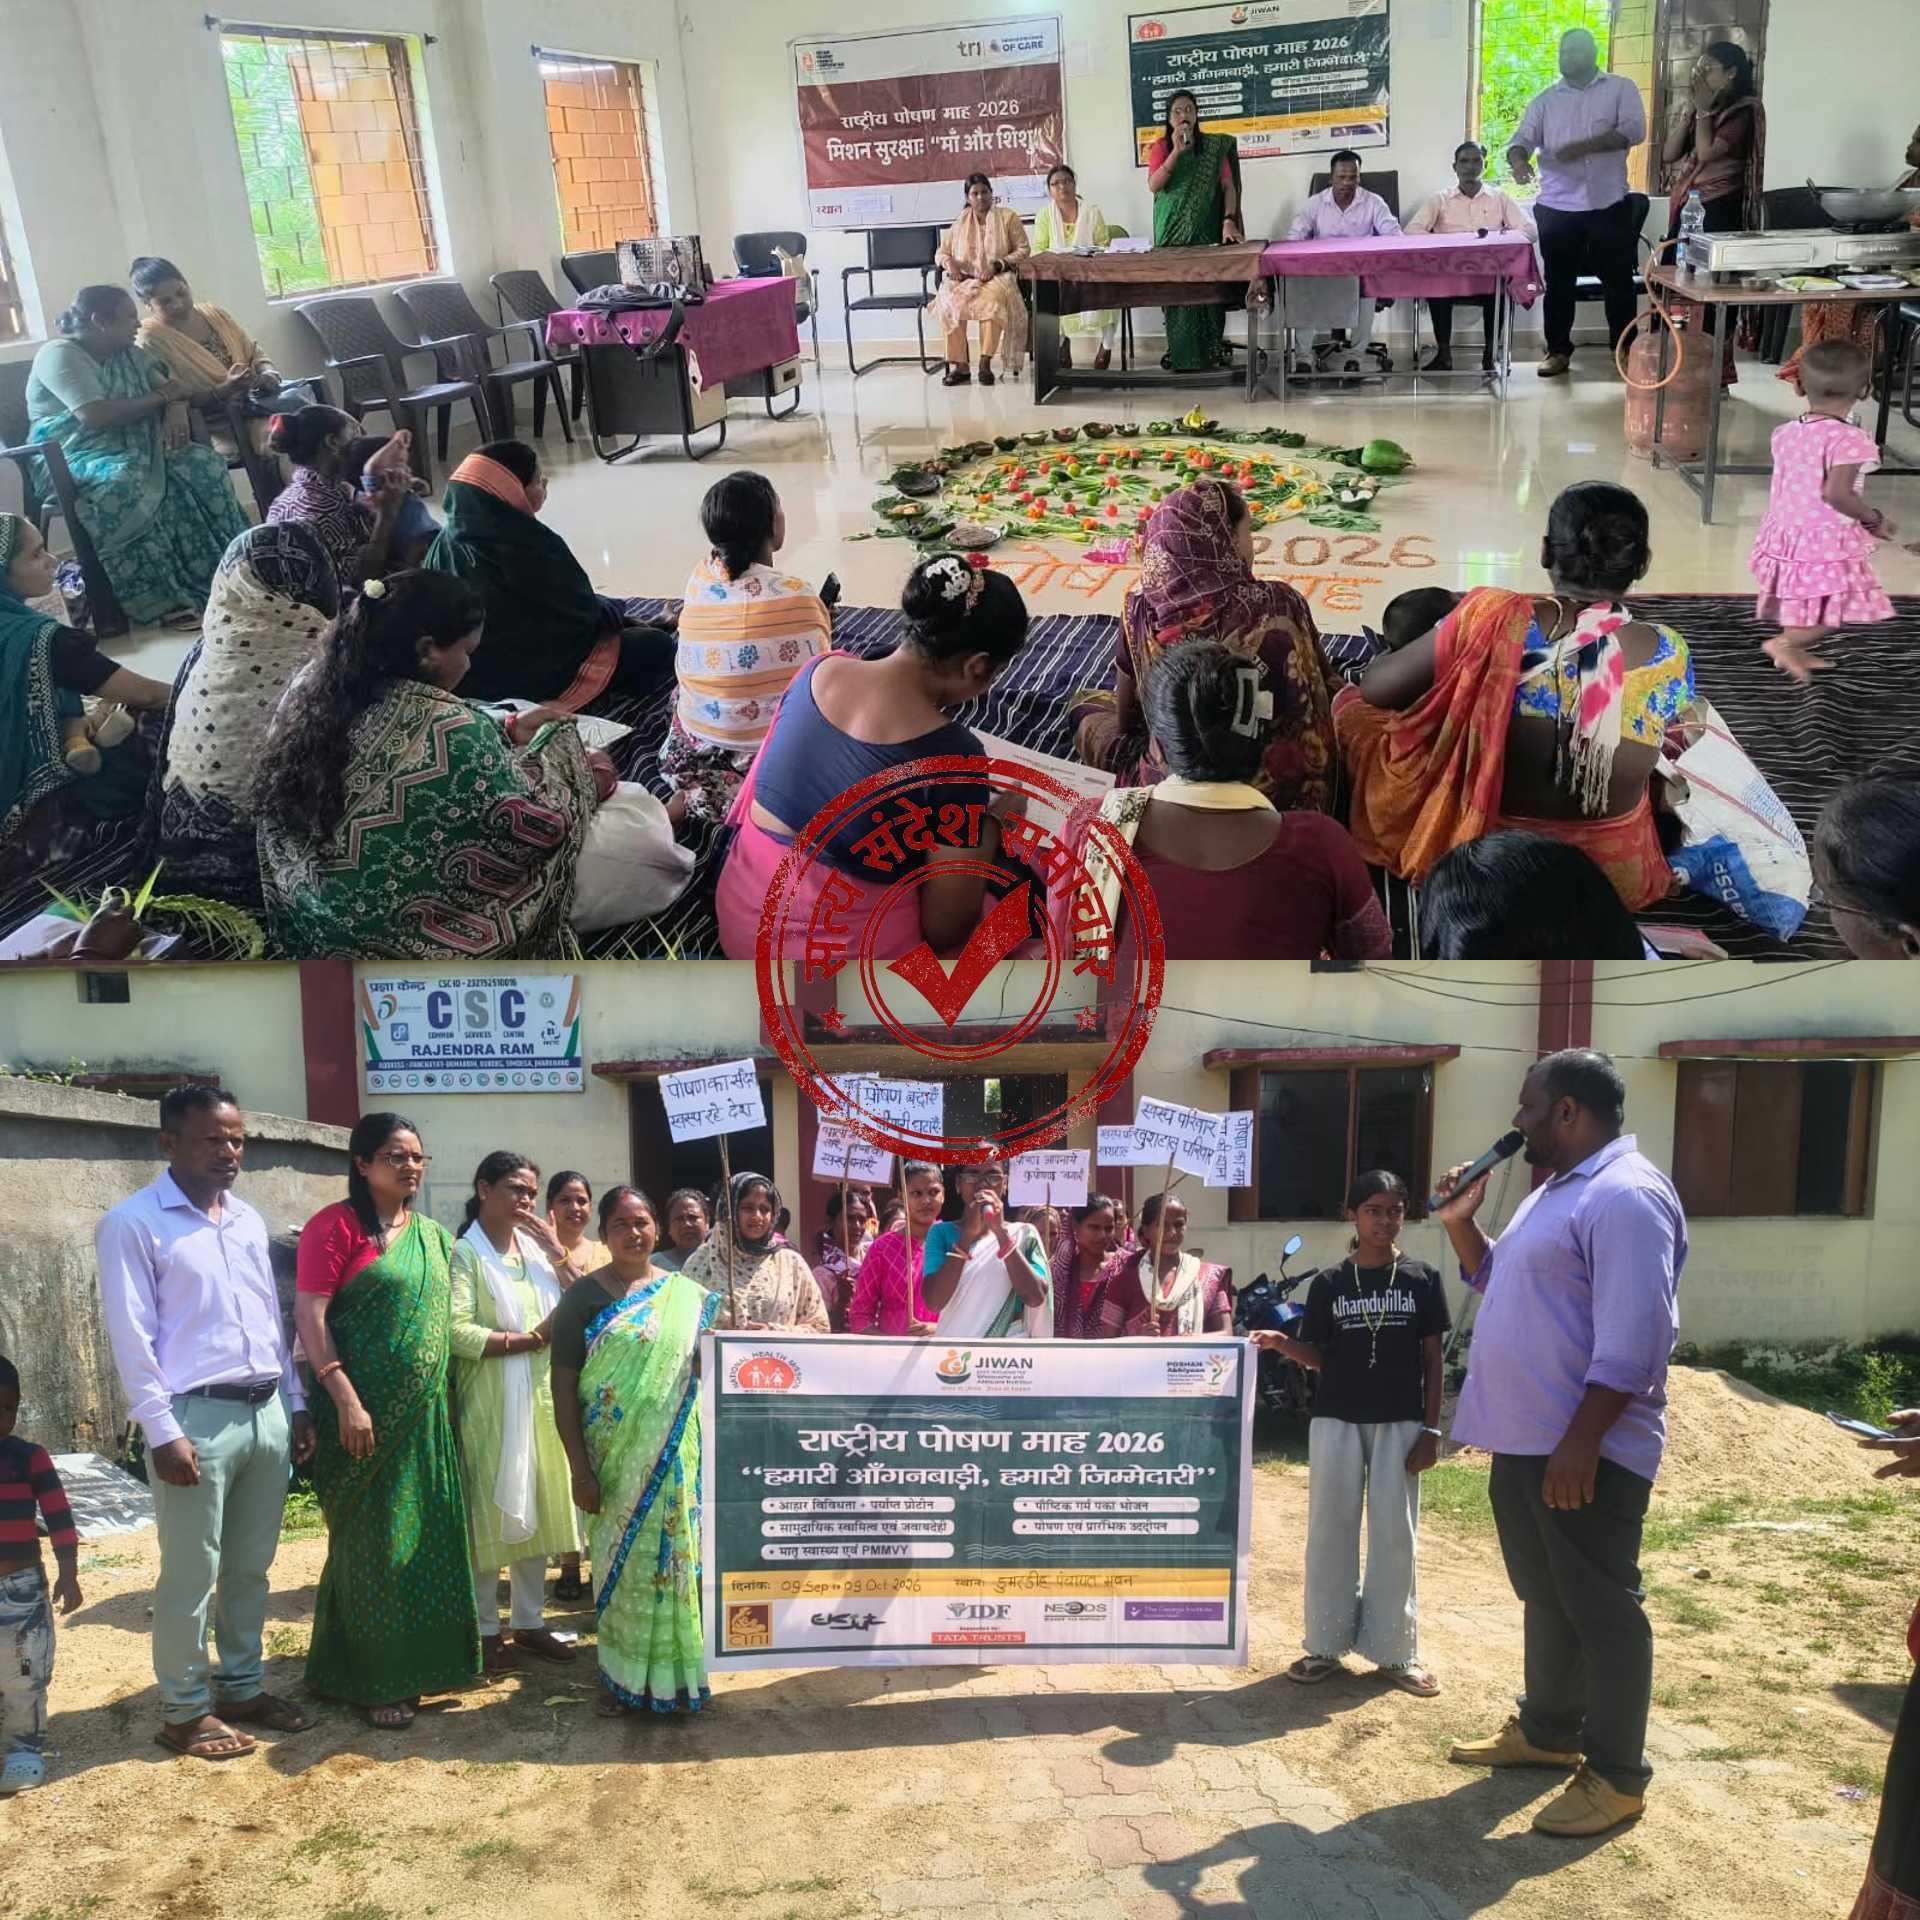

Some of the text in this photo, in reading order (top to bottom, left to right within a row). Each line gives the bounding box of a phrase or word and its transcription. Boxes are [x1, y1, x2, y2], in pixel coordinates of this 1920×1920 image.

[1002, 40, 1044, 52] OF CARE
[1166, 35, 1349, 69] राष्ट्रीय पोषण माह 2026
[1263, 59, 1300, 75] हमारी
[840, 99, 1019, 131] राष्ट्रीय पोषण माह 2026
[826, 137, 871, 162] मिशन
[963, 125, 993, 151] और
[438, 980, 451, 988] CSC
[465, 1031, 492, 1039] SERVICES
[412, 1044, 496, 1056] RAJENDRA
[501, 1043, 535, 1055] RAM
[752, 1351, 787, 1361] HEALTH
[975, 1357, 1033, 1369] JIWAN
[798, 1423, 1165, 1457] राष्ट्रीय पोषण माह 2026
[999, 1463, 1073, 1486] हमारी
[778, 1500, 808, 1511] आहार
[812, 1498, 856, 1511] विविधता
[1076, 1499, 1091, 1511] गर्म
[1095, 1501, 1115, 1511] पका
[1119, 1498, 1149, 1511] भोजन
[779, 1520, 834, 1535] सामुदायिक
[882, 1520, 897, 1534] एवं
[1034, 1520, 1063, 1531] पोषण
[1067, 1520, 1083, 1533] एवं
[842, 1545, 859, 1557] एवं
[862, 1545, 908, 1555] PMMVY
[802, 1580, 829, 1595] Sep
[866, 1579, 887, 1593] Oct
[892, 1578, 922, 1593] 2026
